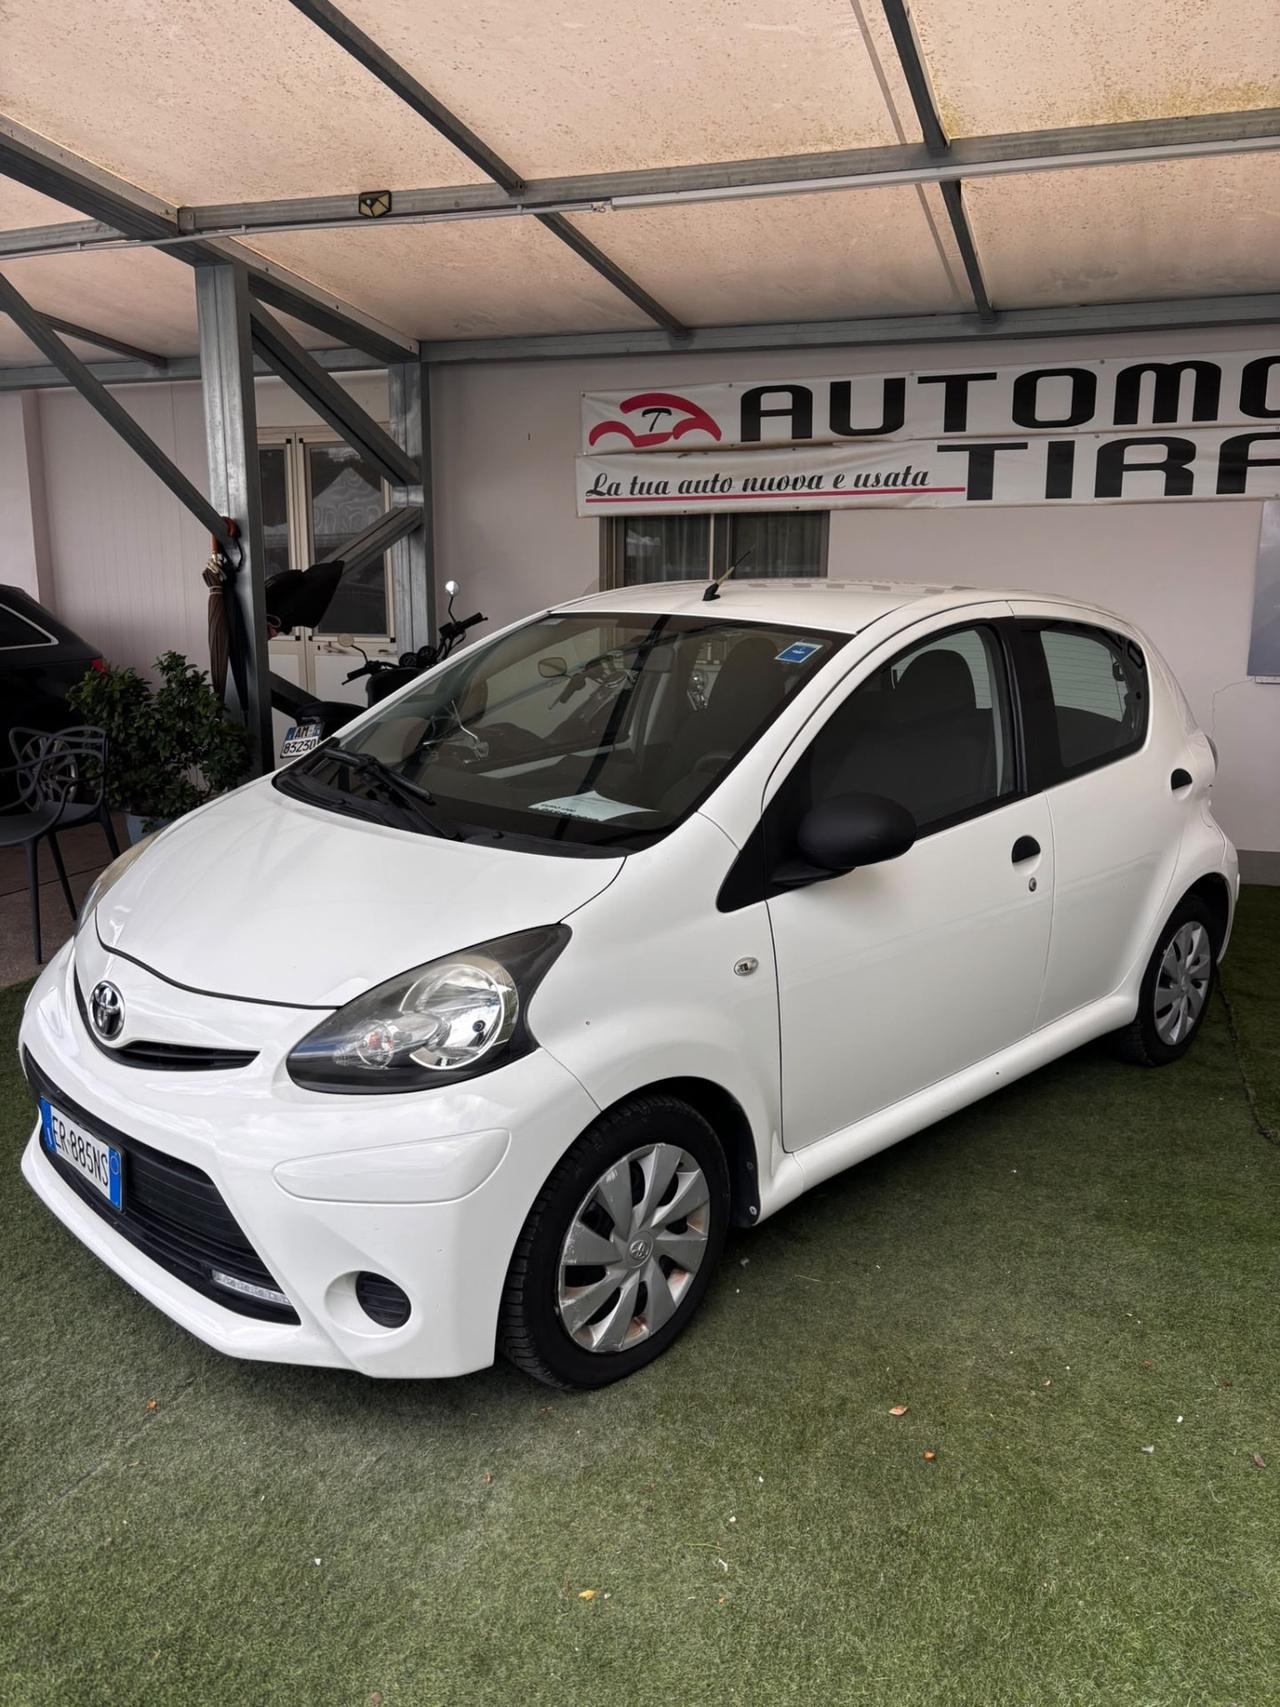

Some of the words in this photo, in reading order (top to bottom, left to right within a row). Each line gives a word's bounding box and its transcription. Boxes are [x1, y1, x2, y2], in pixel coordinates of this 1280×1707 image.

[585, 472, 622, 497] La
[629, 475, 671, 496] tua
[677, 473, 733, 494] auto
[742, 474, 824, 492] nuova
[832, 473, 846, 489] e
[853, 465, 930, 488] usata
